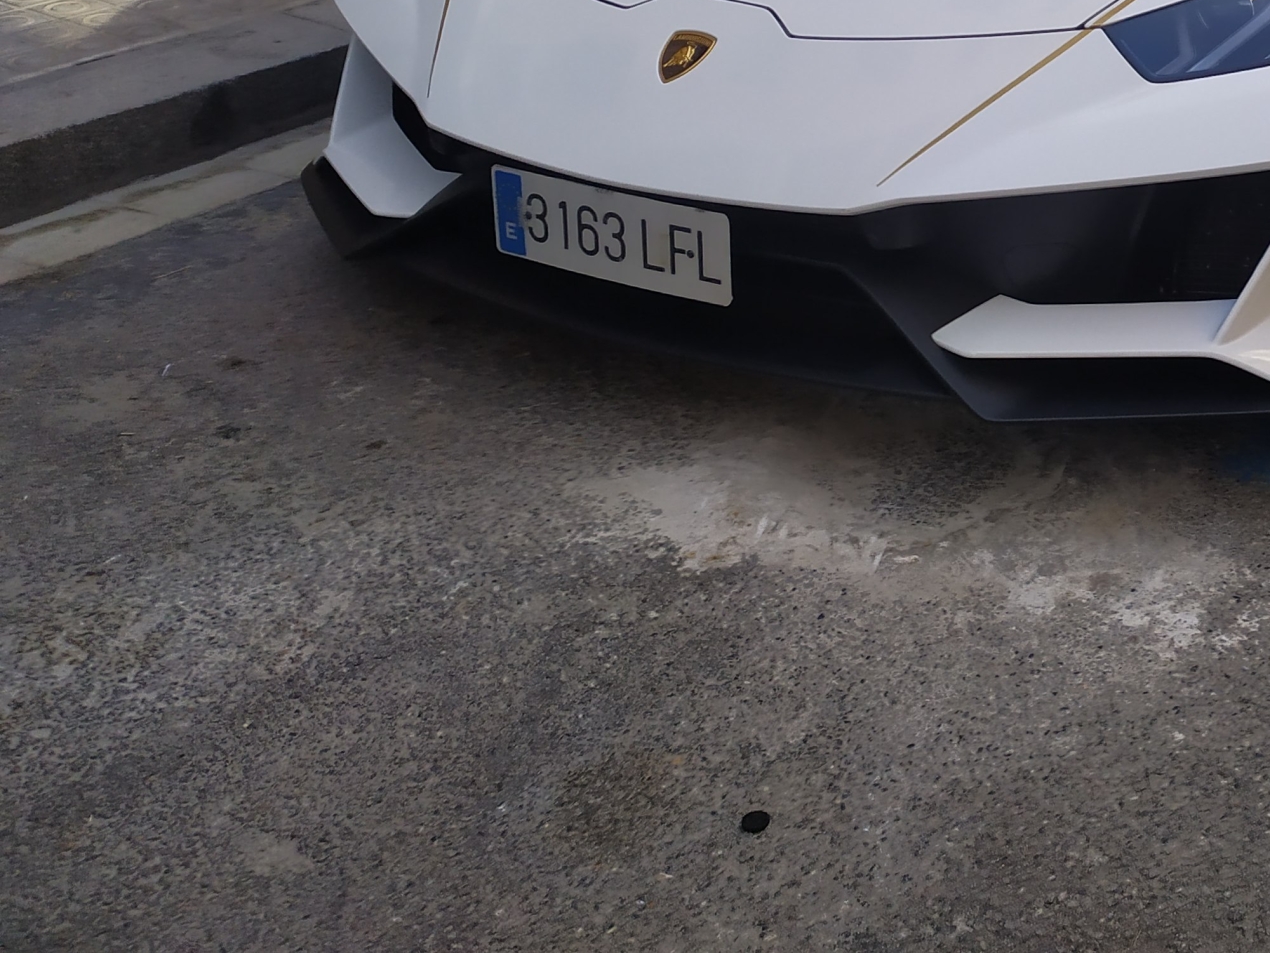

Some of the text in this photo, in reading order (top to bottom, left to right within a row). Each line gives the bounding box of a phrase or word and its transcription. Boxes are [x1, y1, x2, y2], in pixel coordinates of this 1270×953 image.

[505, 221, 518, 240] E
[525, 193, 722, 285] 3163 LFL
